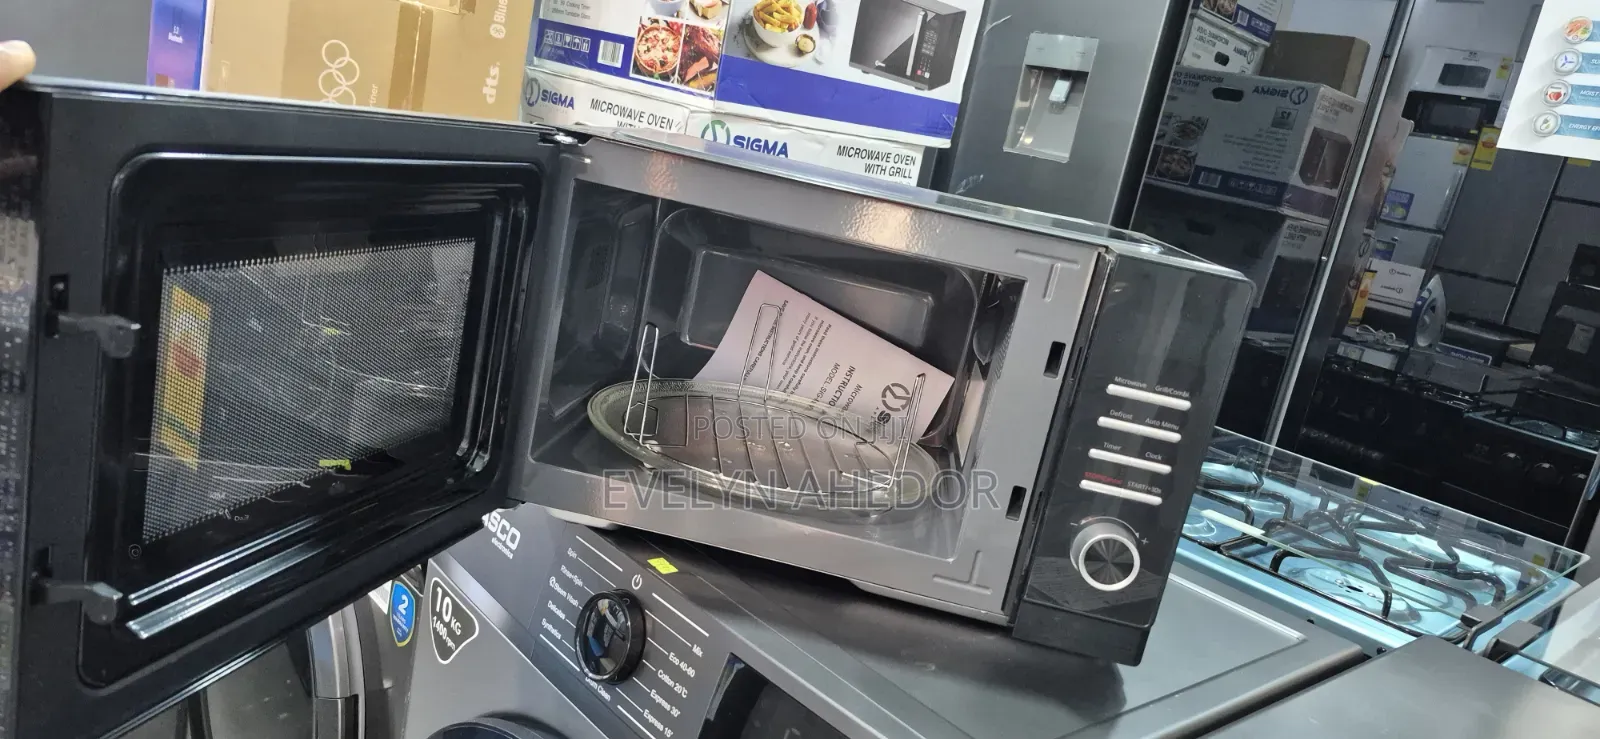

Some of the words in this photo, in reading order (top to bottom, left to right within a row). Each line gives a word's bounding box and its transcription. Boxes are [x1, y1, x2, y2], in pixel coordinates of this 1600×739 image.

[541, 89, 574, 110] SIGMA
[590, 98, 645, 123] MICROWAVE
[647, 113, 674, 130] OVEN
[1568, 122, 1591, 130] ENERGY
[733, 134, 789, 158] SIGMA
[836, 144, 892, 164] MICROWAVE
[893, 153, 916, 166] OVEN
[864, 162, 887, 174] WITH
[888, 166, 913, 179] GRILL
[829, 364, 855, 407] INSTRUCTIO
[1114, 376, 1147, 389] Microwave
[1155, 385, 1190, 398] Grill/Combi
[1110, 409, 1133, 420] Defrost
[1145, 418, 1161, 427] Auto
[1162, 420, 1180, 431] Menu
[1103, 442, 1122, 452] Timer
[1145, 452, 1162, 461] Clock
[567, 548, 578, 559] Spin
[398, 594, 408, 616] 2
[566, 592, 579, 607] Wash
[436, 586, 452, 622] 10
[450, 616, 462, 636] KG
[433, 616, 447, 640] 1400
[446, 636, 456, 651] rpm
[692, 644, 704, 658] Mix
[668, 652, 680, 666] Eco
[680, 662, 696, 678] 40-60
[658, 669, 675, 688] Cotton
[650, 689, 671, 712] Express
[643, 708, 664, 732] Express
